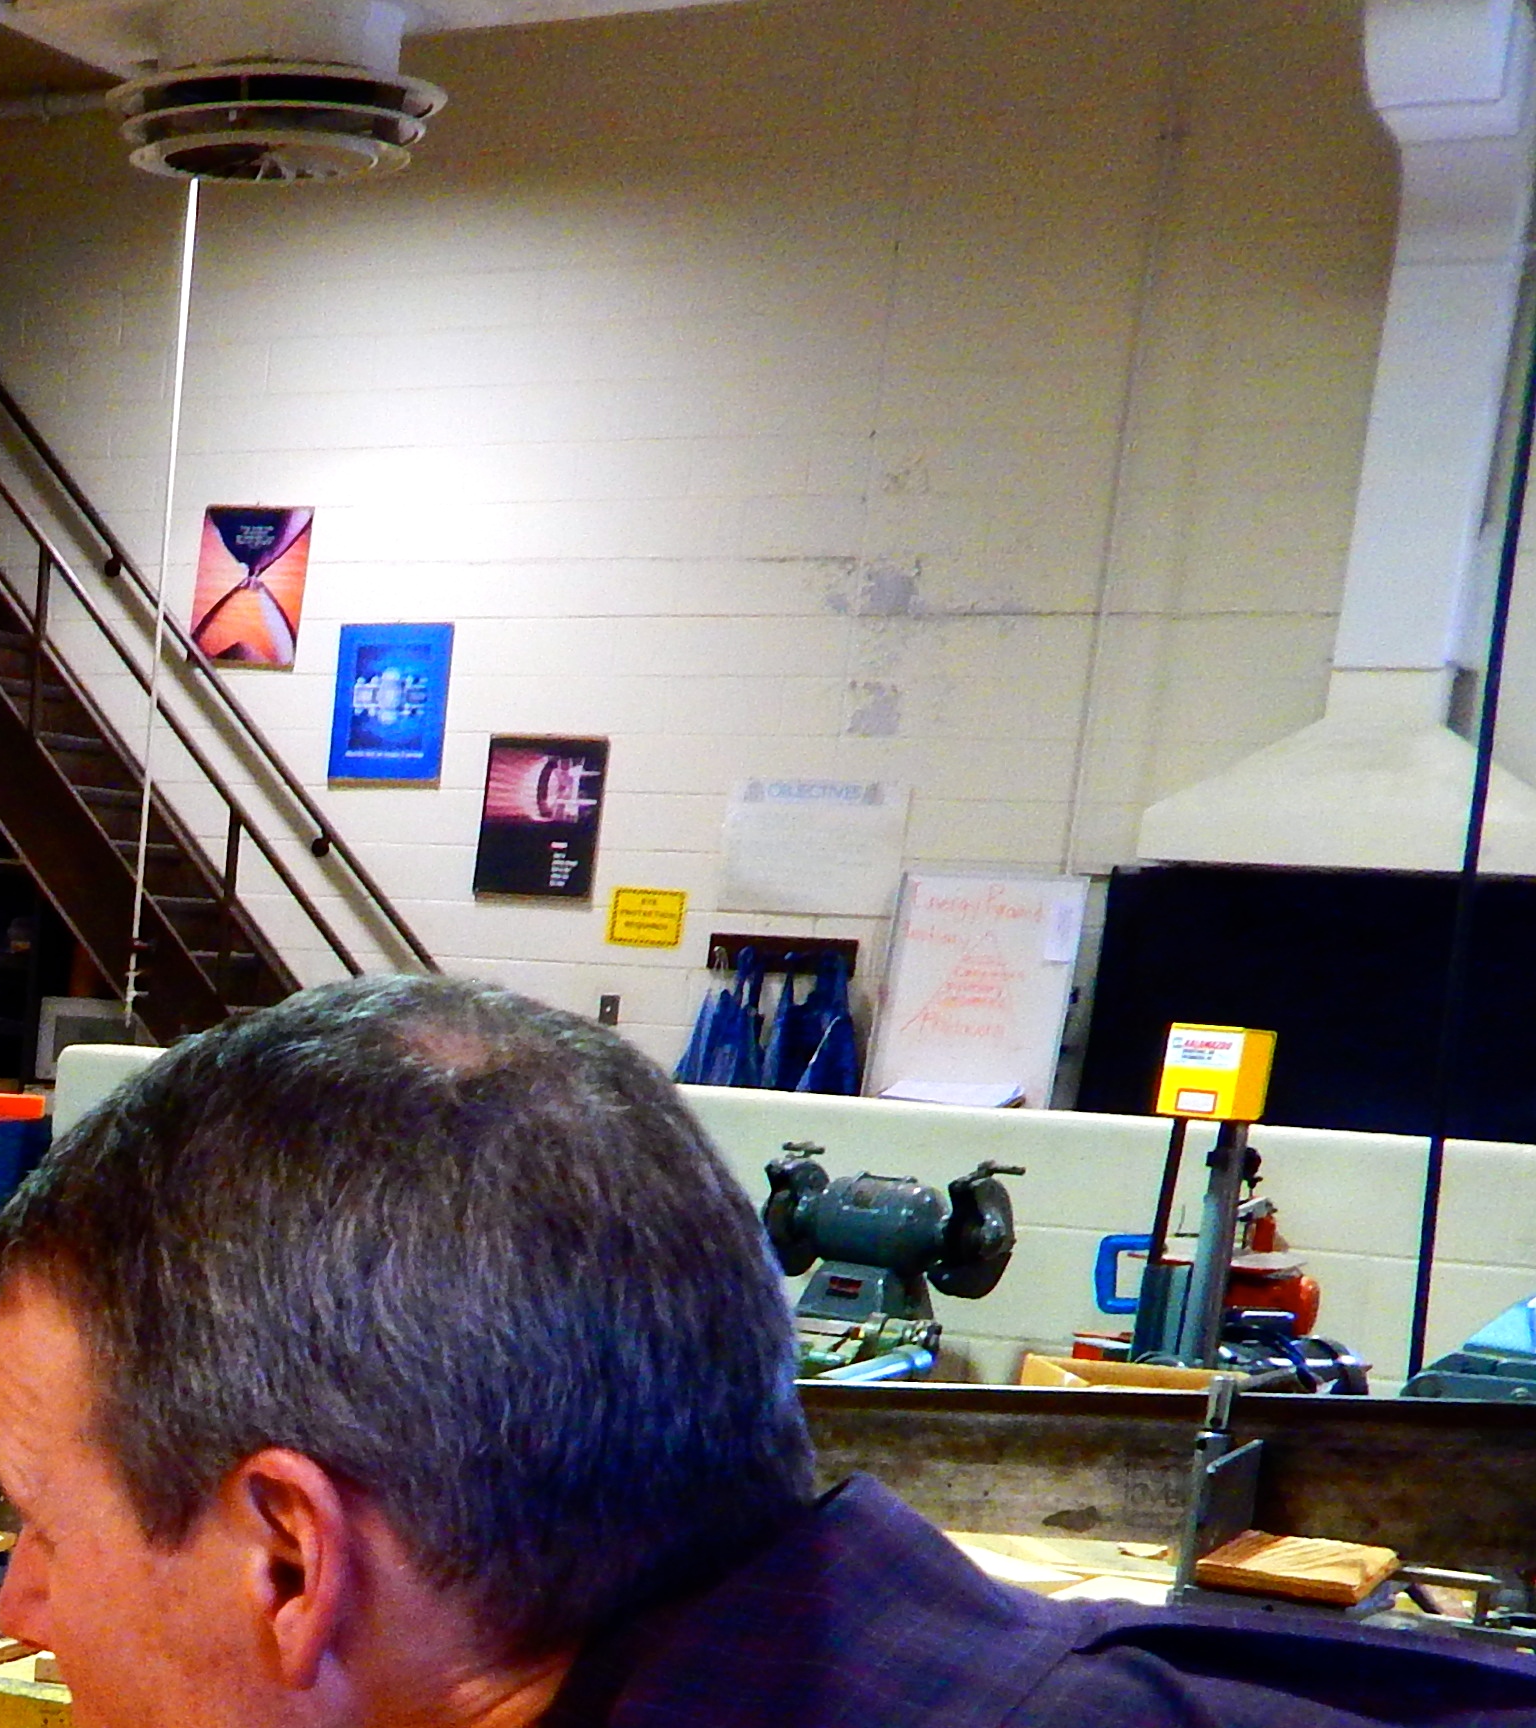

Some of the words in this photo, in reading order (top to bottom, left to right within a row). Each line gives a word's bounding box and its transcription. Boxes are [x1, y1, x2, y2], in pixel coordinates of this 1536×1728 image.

[767, 783, 863, 799] OBJECTIVES
[619, 909, 676, 918] PROTECTION
[1184, 1039, 1233, 1050] KALAMAZOO
